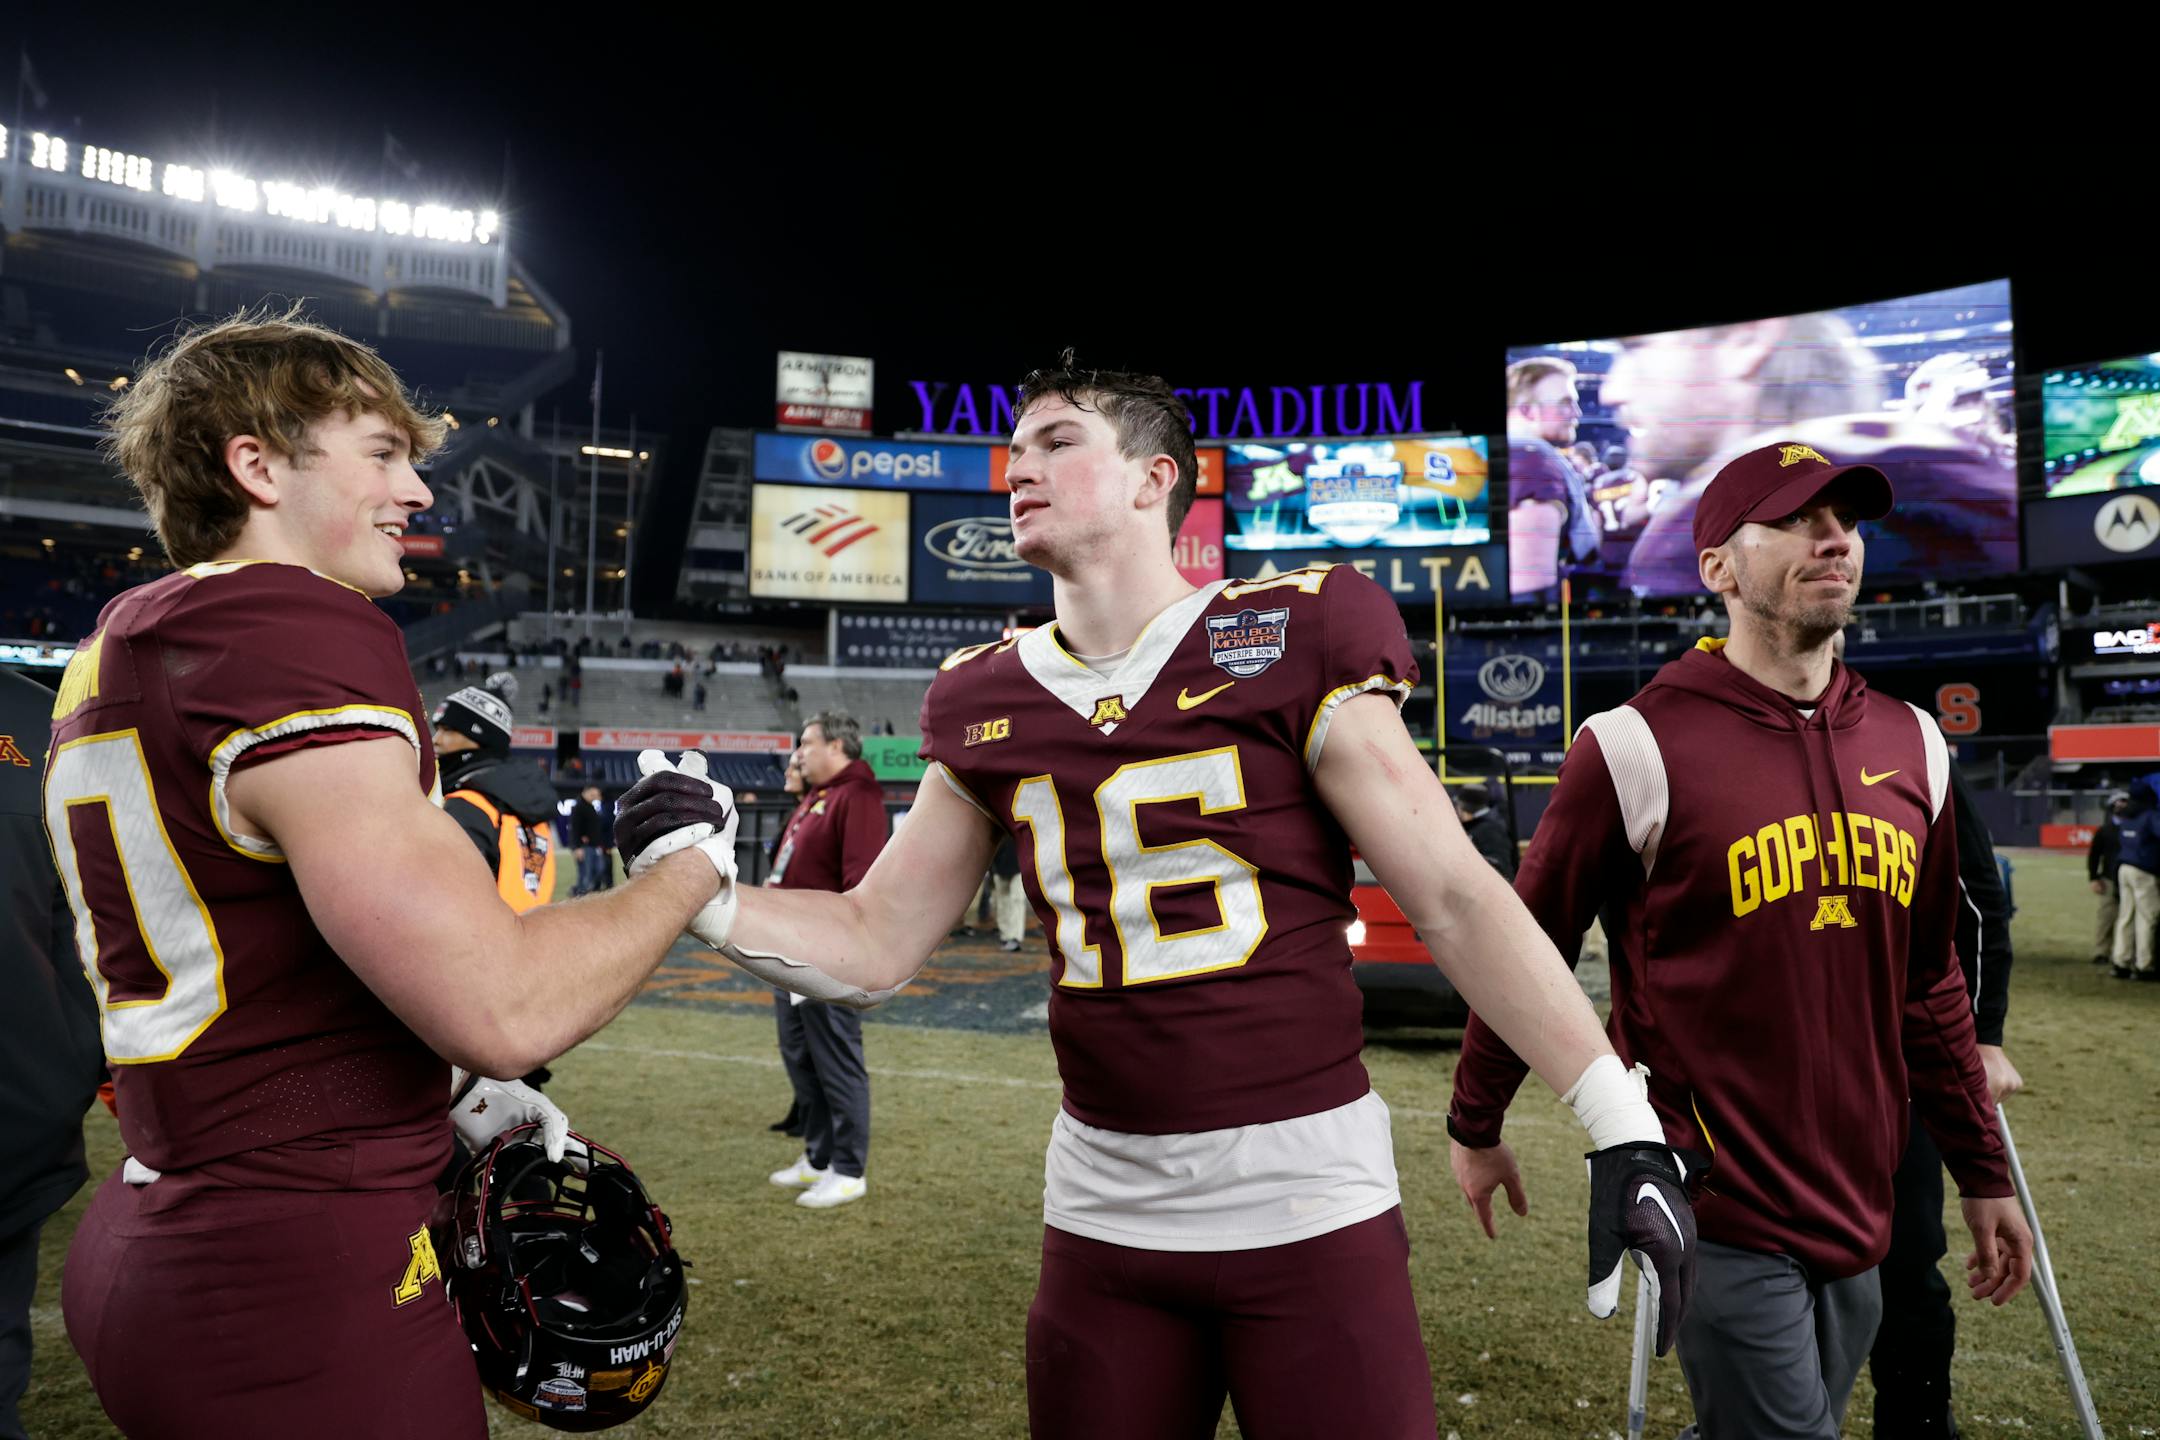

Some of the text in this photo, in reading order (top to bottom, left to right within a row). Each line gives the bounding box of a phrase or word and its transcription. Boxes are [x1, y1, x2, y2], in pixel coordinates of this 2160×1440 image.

[909, 380, 1022, 434] YAN
[851, 449, 943, 481] pepsi
[754, 568, 904, 585] BANK OF AMERICA
[1214, 626, 1280, 640] BAD BOY
[1214, 634, 1280, 649] MOWERS
[1216, 648, 1278, 662] PINSTRIPE BOWL
[1460, 703, 1561, 728] Allstate
[1936, 683, 1982, 735] S
[1011, 745, 1269, 988] 16
[1727, 811, 1917, 918] GOPHERS
[610, 1306, 682, 1366] SKI-U-MAH
